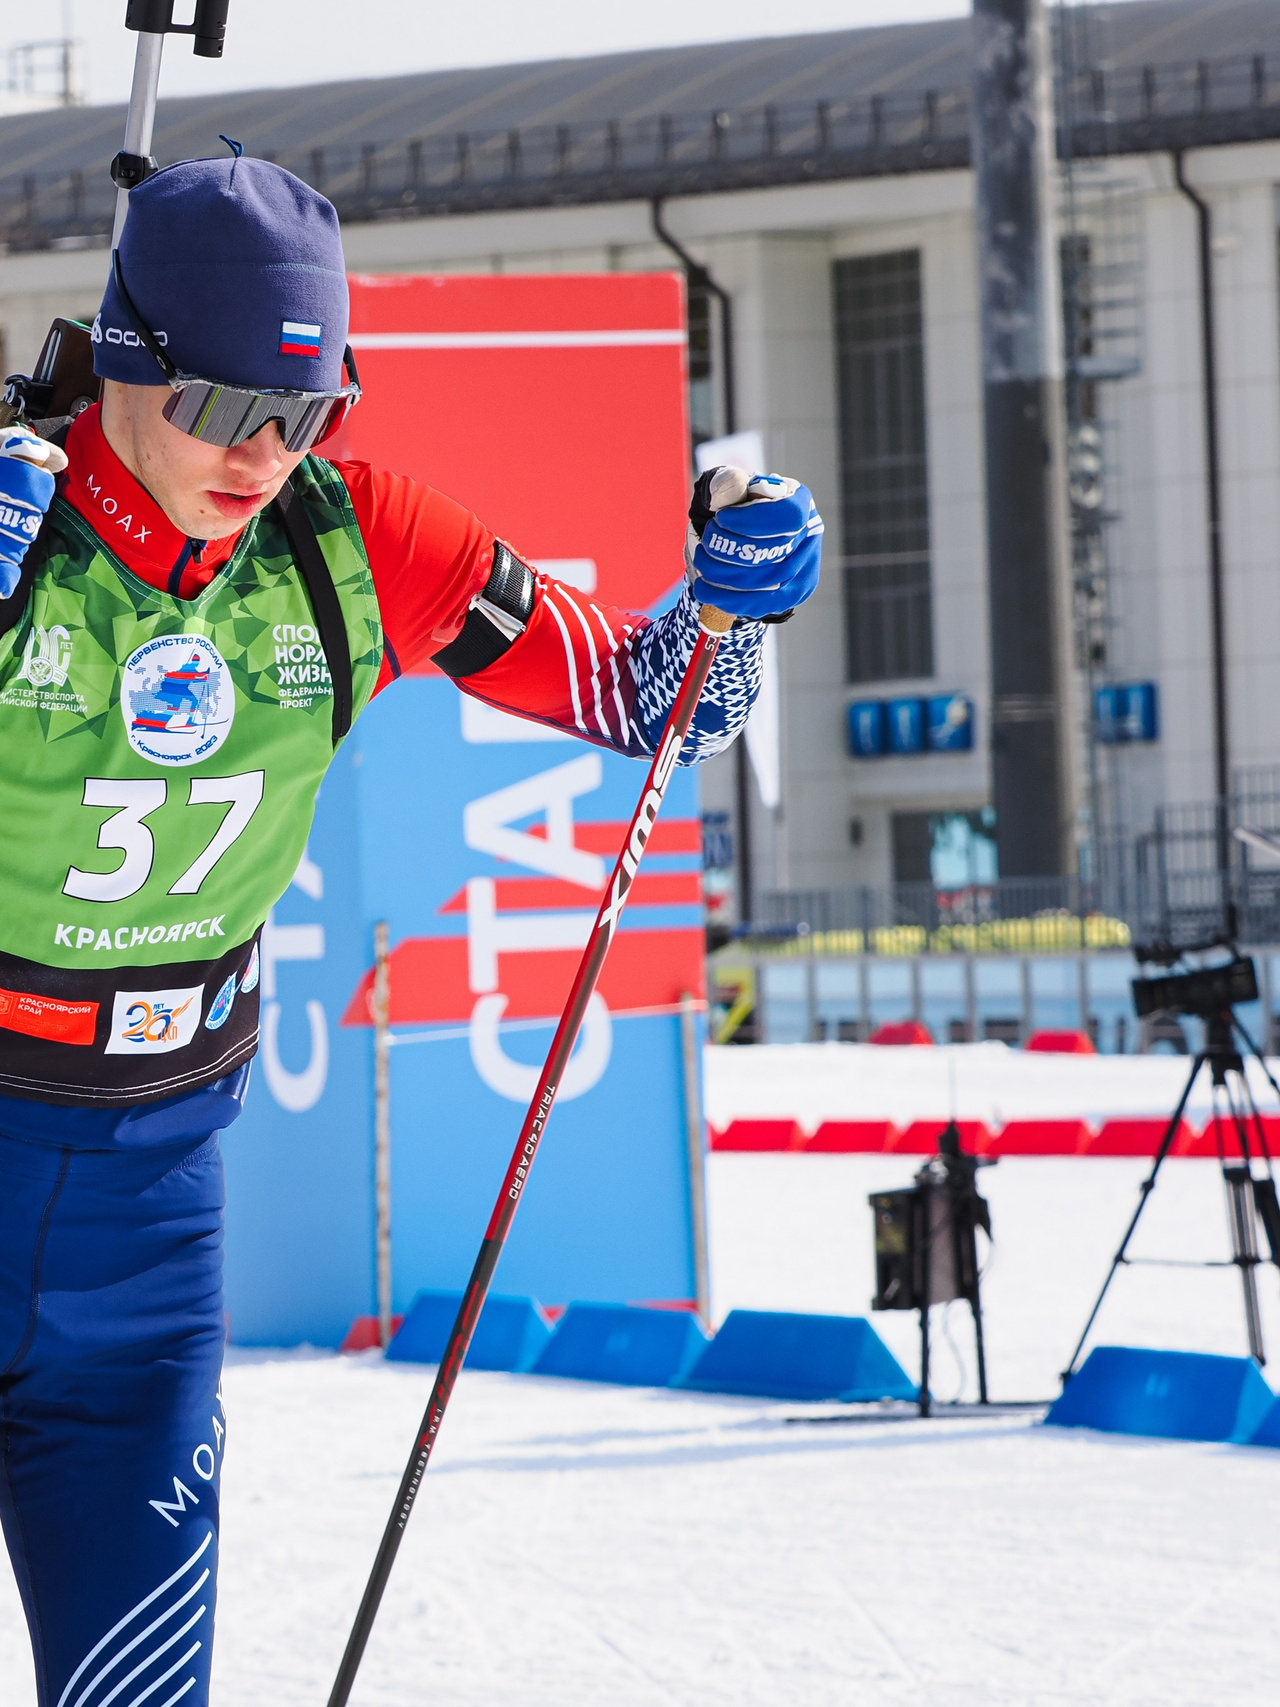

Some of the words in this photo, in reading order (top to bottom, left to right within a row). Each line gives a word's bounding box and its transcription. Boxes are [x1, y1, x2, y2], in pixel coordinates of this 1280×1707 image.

[86, 474, 152, 544] MOAX
[272, 624, 321, 644] СПО
[127, 637, 194, 671] ПЕРВЕНСТВО
[195, 638, 223, 669] РОССИИ
[274, 644, 327, 665] НОР
[276, 664, 333, 686] ЖИЗН
[55, 692, 85, 703] СПОРТА
[278, 685, 335, 698] ФЕДЕРАЛЬН
[39, 701, 88, 713] ФЕДЕРАЦИИ
[279, 698, 313, 710] ПРОЕКТ
[136, 739, 192, 762] Красноярск
[195, 735, 218, 755] 2023
[61, 769, 266, 903] 37
[461, 556, 613, 1104] СТА
[53, 914, 226, 952] КРАСНОЯРСК
[17, 1003, 43, 1016] КРАЙ
[19, 996, 92, 1015] КРАСНОЯРСКИЙ
[532, 1085, 556, 1131] TRIAC
[508, 1155, 529, 1200] AERO
